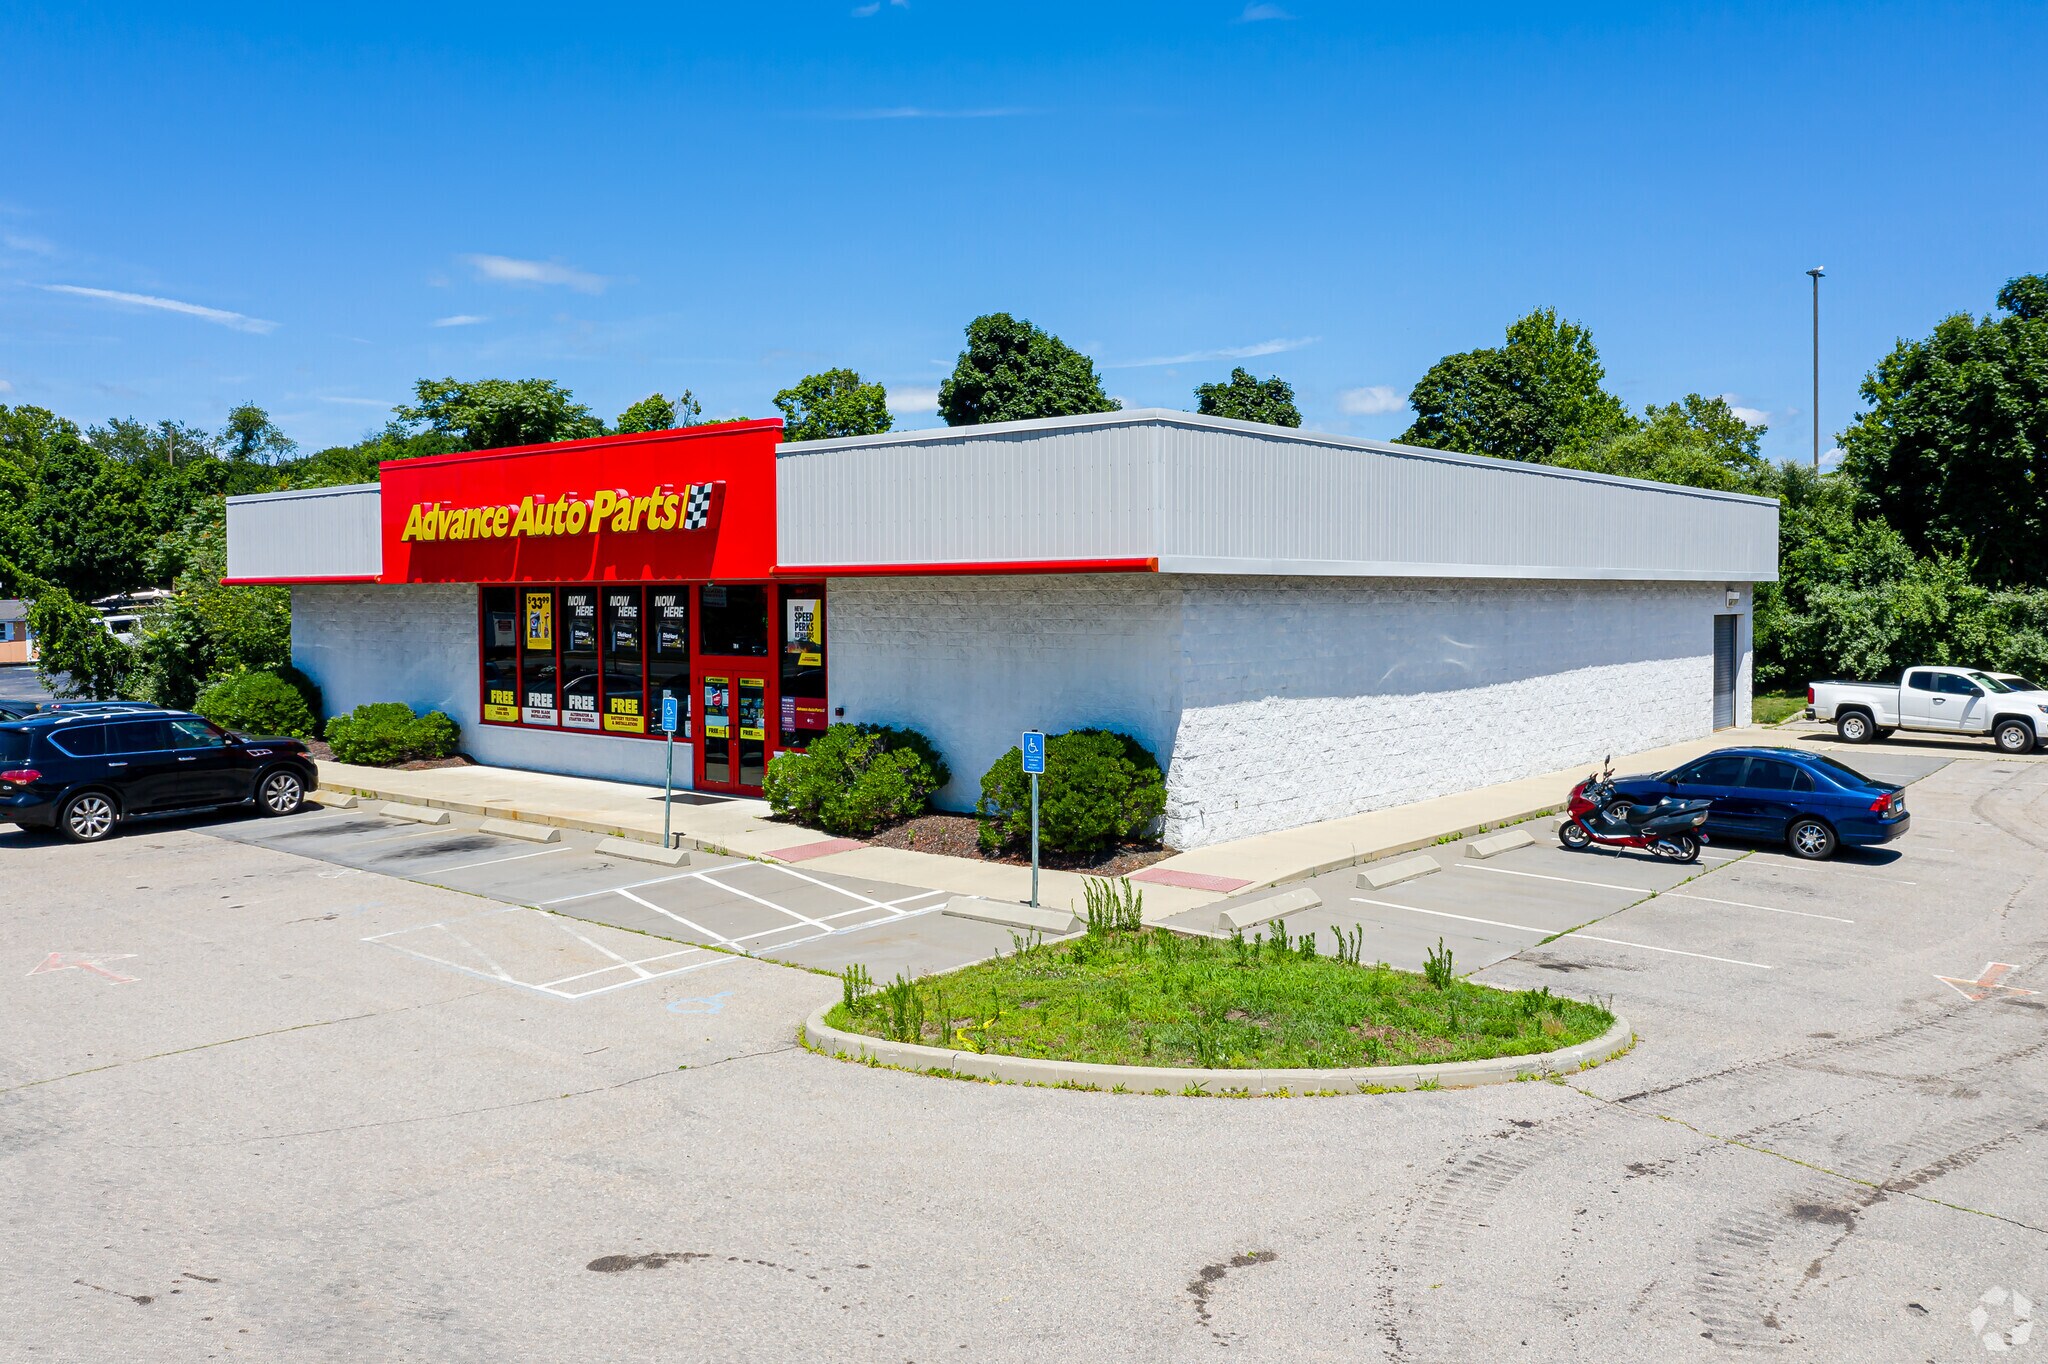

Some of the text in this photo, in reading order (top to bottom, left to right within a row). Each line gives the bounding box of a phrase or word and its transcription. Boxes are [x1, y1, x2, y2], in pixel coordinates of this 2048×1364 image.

[401, 486, 679, 542] Advance Auto Parts
[567, 595, 586, 606] NOW
[609, 595, 630, 607] NOW
[654, 595, 676, 607] NOW
[575, 606, 594, 616] HERE
[618, 606, 638, 617] HERE
[663, 606, 684, 617] HERE
[794, 612, 814, 622] SPEED
[794, 622, 814, 631] PERKS
[491, 690, 514, 705] FREE
[528, 692, 553, 708] FREE
[568, 694, 594, 711] FREE
[611, 698, 638, 714] FREE
